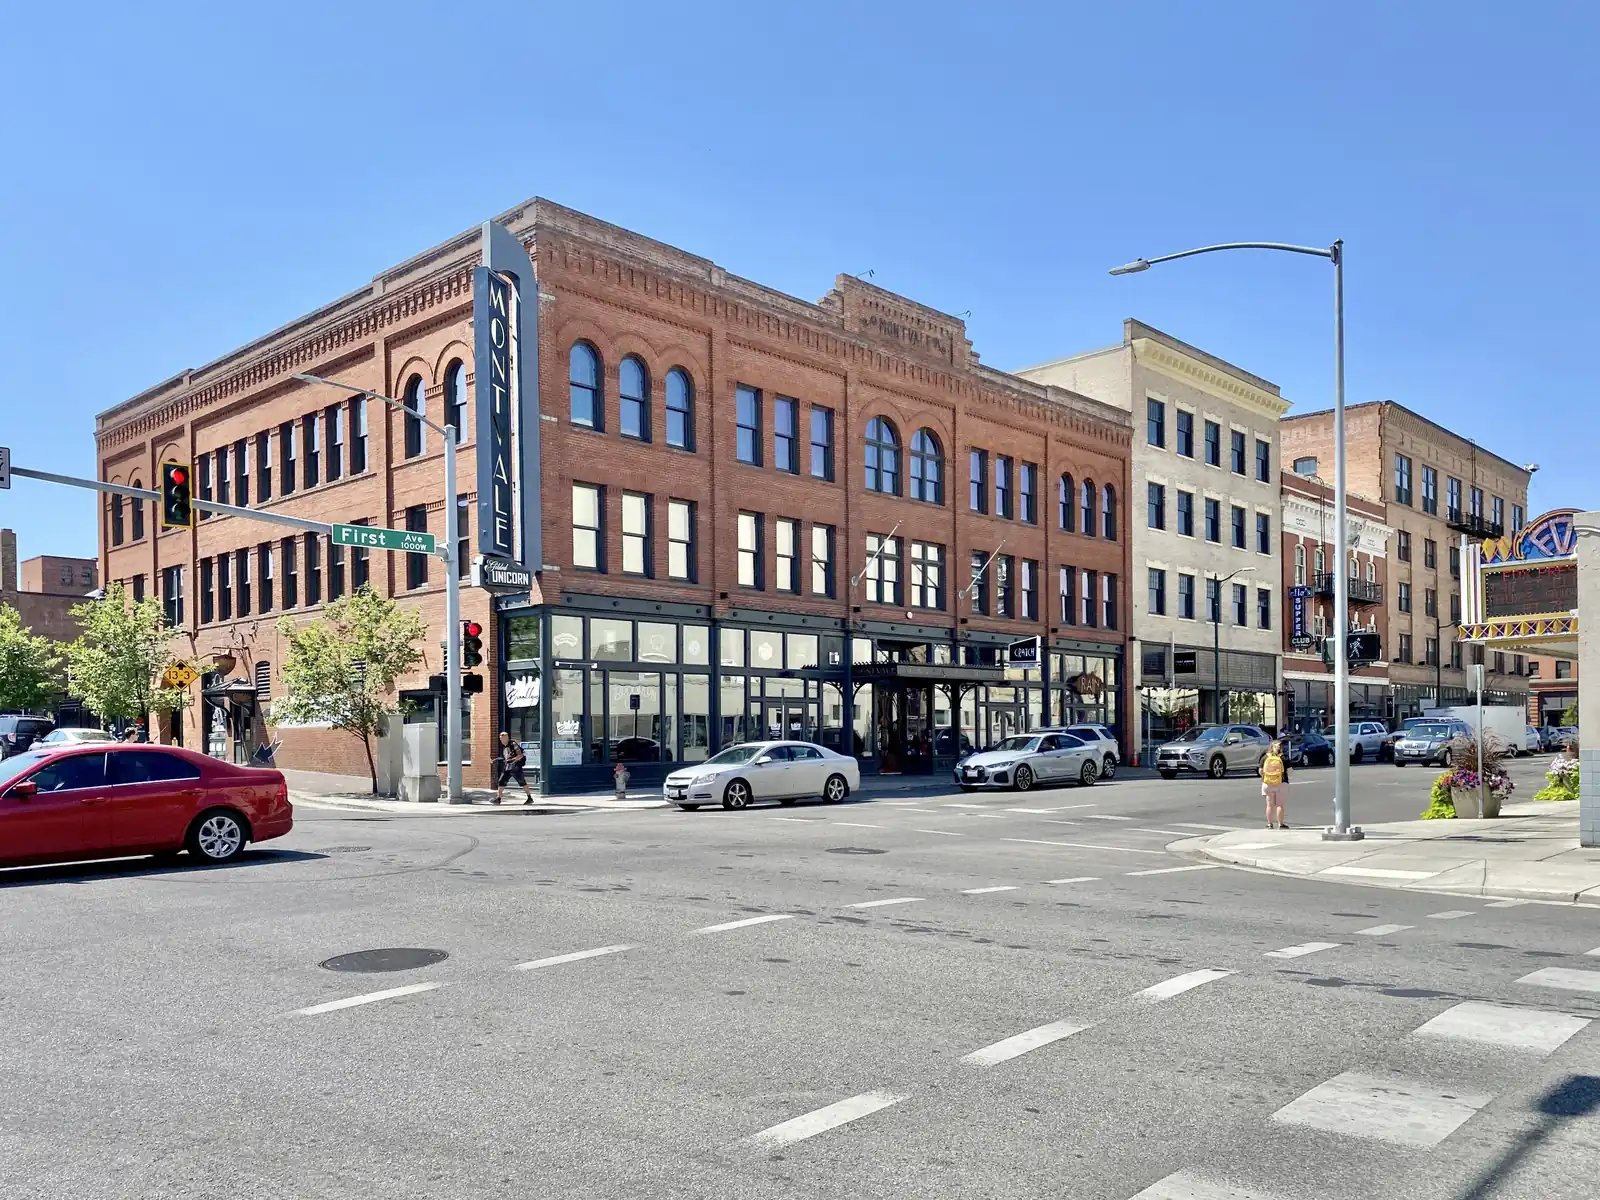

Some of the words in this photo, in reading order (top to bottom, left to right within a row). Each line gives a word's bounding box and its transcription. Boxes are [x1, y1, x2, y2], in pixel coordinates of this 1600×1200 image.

[489, 282, 508, 548] MONTVALE
[341, 527, 386, 546] First
[404, 533, 423, 543] Ave
[400, 541, 427, 551] 1000W
[491, 570, 529, 586] UNICORN
[1294, 597, 1302, 636] SUPPER
